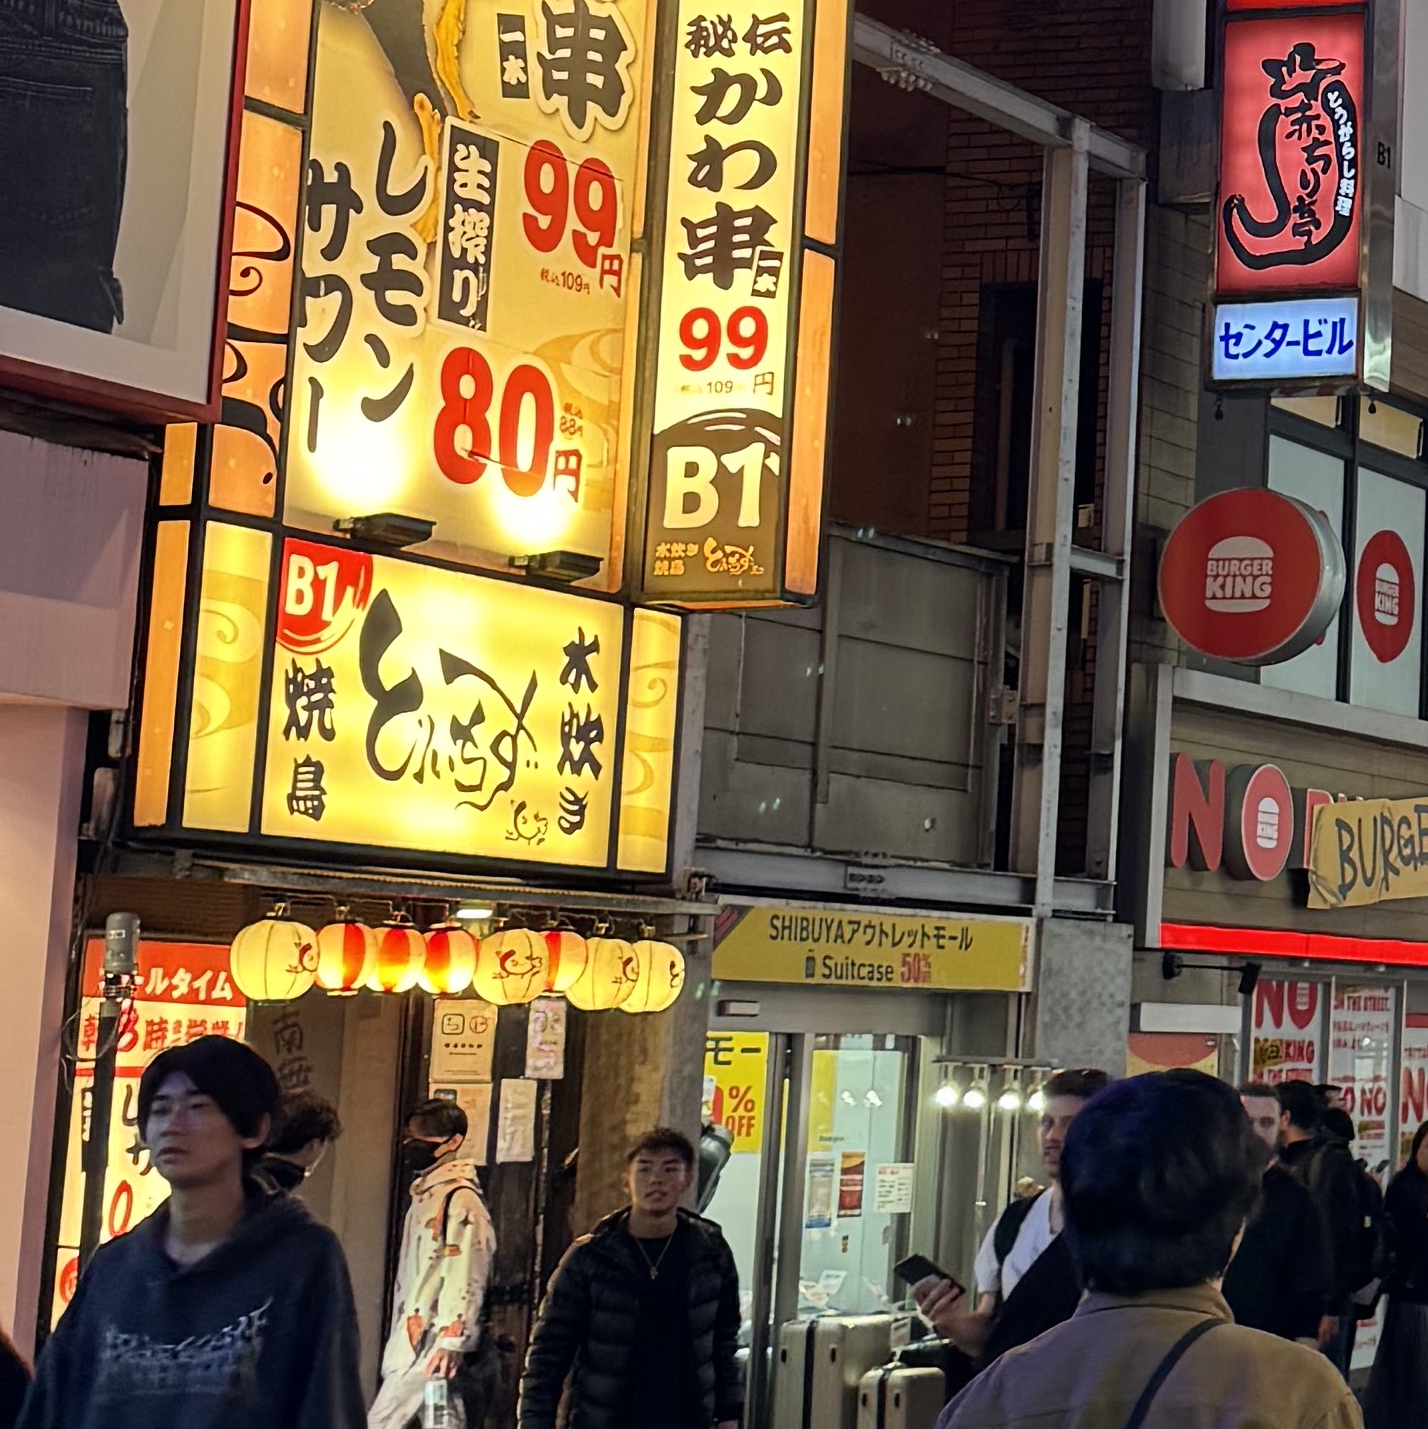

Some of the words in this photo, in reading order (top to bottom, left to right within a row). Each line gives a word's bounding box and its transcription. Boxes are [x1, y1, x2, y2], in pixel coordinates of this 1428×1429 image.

[684, 12, 793, 59] 秘伝
[677, 68, 784, 291] かわ串
[1377, 141, 1391, 170] B1
[522, 139, 618, 269] 99
[360, 120, 428, 424] レモン
[598, 249, 624, 298] 円
[679, 306, 768, 371] 99
[1219, 316, 1355, 360] センタービル
[753, 372, 774, 396] 円
[434, 346, 555, 497] 80
[553, 448, 583, 504] 円
[663, 442, 765, 529] B1
[283, 552, 338, 628] B1
[1205, 576, 1272, 598] KING
[1206, 559, 1273, 576] BURGER
[1375, 592, 1398, 615] KING
[282, 657, 339, 822] 焼鳥
[556, 626, 606, 836] 水炊き
[769, 914, 974, 951] SHIBUYAアウトレットモール
[822, 955, 894, 982] Suitcase
